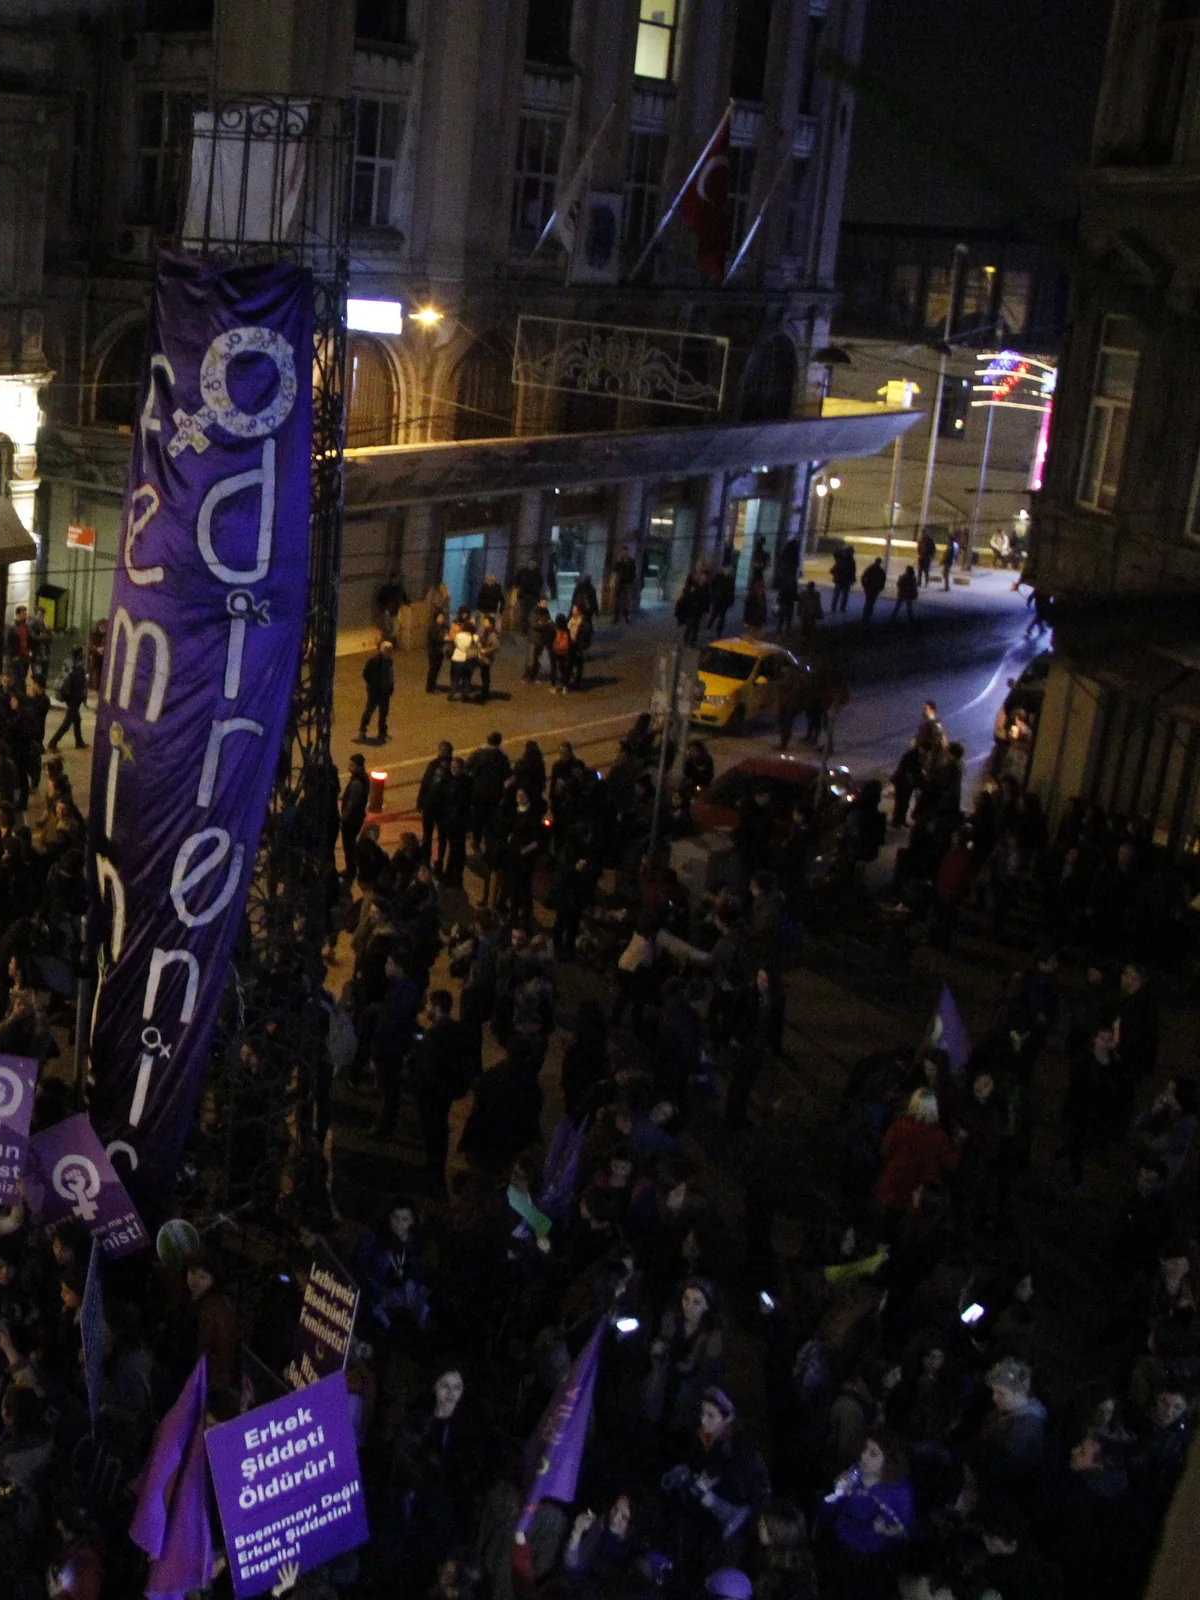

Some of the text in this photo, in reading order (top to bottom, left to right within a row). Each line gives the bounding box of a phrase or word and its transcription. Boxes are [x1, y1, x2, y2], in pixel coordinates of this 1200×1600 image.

[240, 1425, 325, 1482] Şiddeti
[244, 1407, 314, 1450] Erkek
[238, 1450, 336, 1509] Öldürür!
[234, 1504, 318, 1550] Boşanmayı
[237, 1502, 352, 1566] Erkek Şiddetini
[240, 1541, 301, 1580] Engelle!
